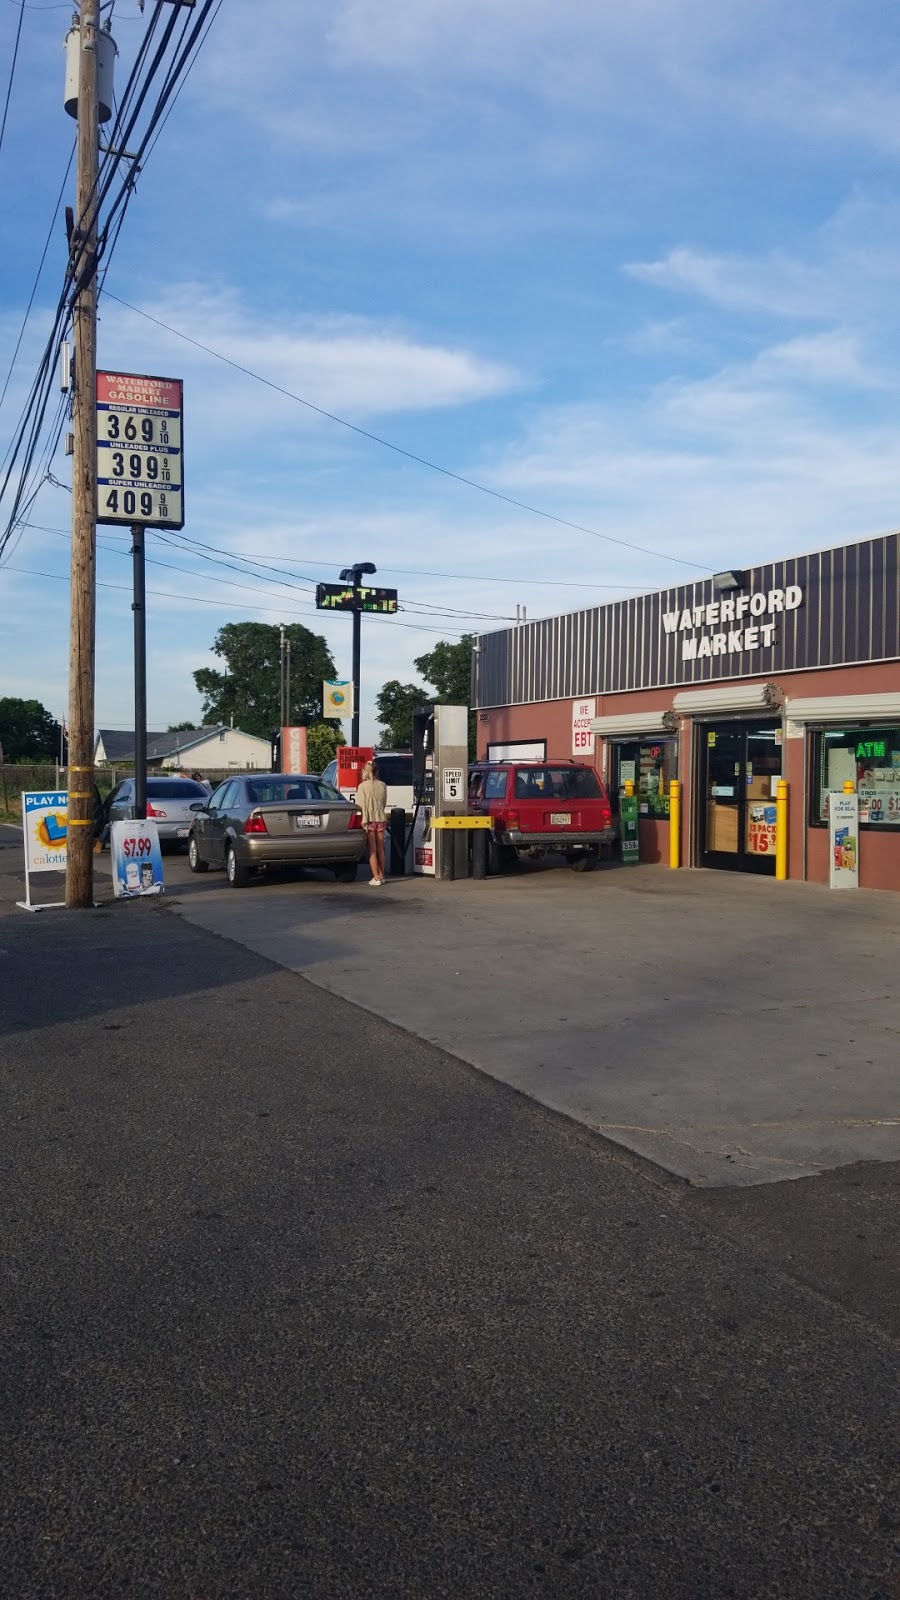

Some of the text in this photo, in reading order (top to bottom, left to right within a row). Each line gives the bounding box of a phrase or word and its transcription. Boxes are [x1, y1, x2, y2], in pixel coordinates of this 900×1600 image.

[106, 375, 172, 389] WATERFORD
[118, 385, 161, 396] MARKET
[109, 391, 170, 404] GASOLINE
[109, 405, 169, 416] REGULAR UNLEADED
[108, 415, 153, 442] 369
[110, 442, 148, 450] UNLEADED
[112, 452, 158, 480] 399
[109, 479, 172, 490] SUPER UNLEADED
[106, 489, 153, 516] 409
[662, 585, 803, 634] WATERFORD
[682, 623, 776, 661] MARKET
[579, 705, 589, 715] WE
[574, 718, 593, 728] ACCEP
[575, 732, 592, 747] EBT
[856, 741, 885, 758] ATM
[450, 785, 457, 797] 5
[26, 796, 54, 806] PLAY
[750, 824, 757, 832] 12
[123, 837, 152, 858] $7.99
